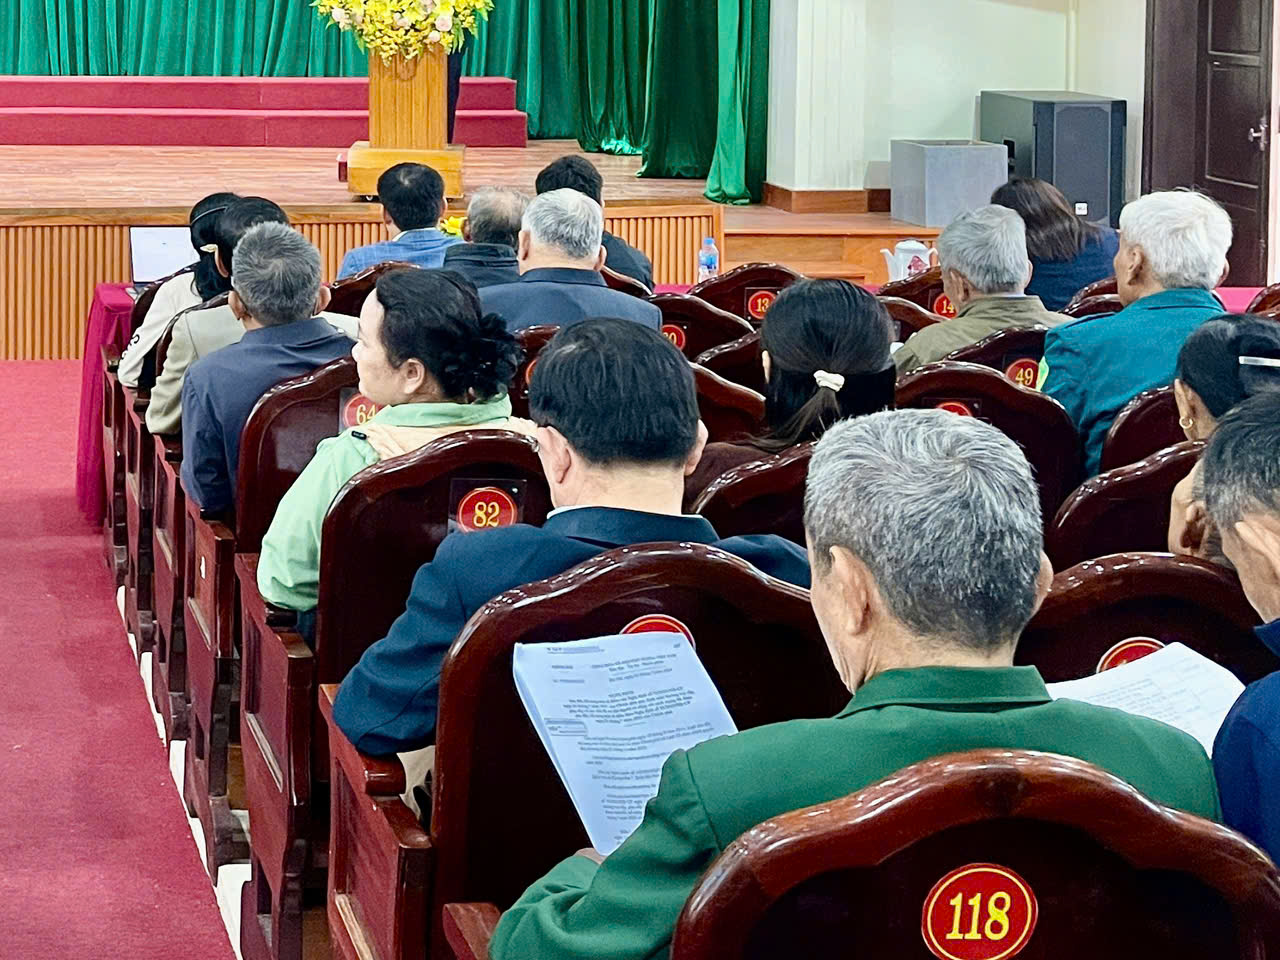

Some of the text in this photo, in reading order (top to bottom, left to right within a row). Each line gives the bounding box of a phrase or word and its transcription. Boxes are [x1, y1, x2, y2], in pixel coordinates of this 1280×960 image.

[1015, 368, 1034, 386] 49
[473, 501, 500, 527] 82
[946, 891, 1011, 941] 118
